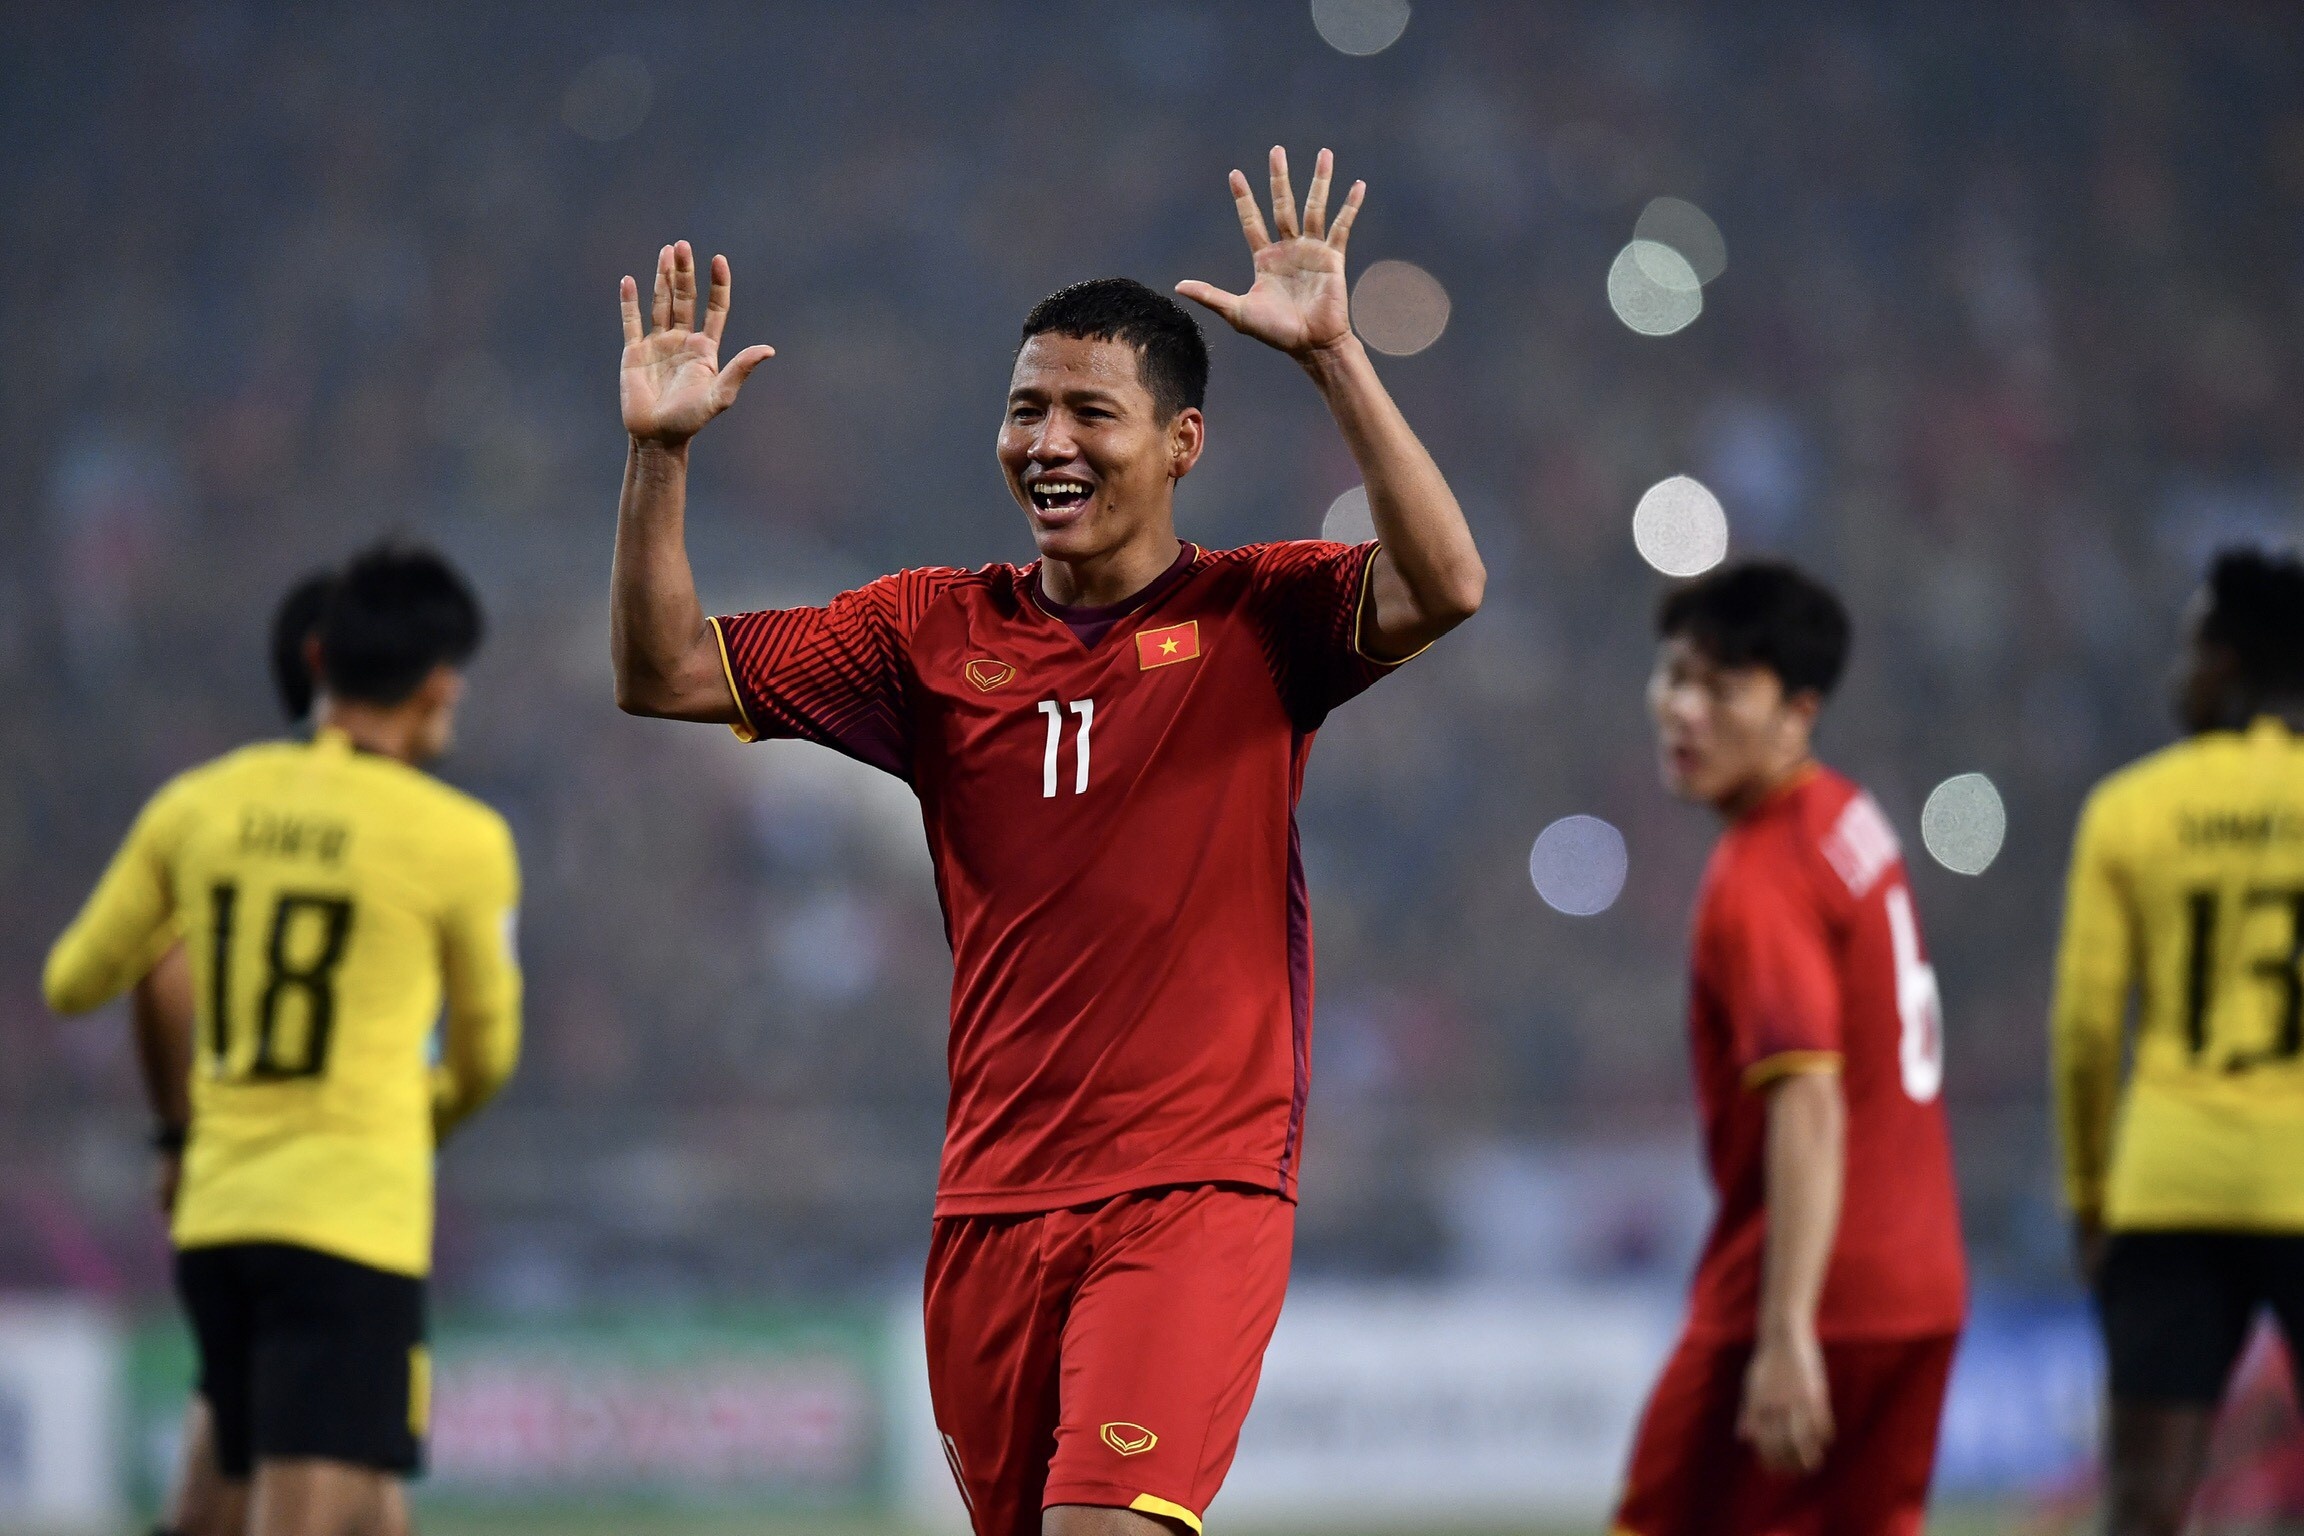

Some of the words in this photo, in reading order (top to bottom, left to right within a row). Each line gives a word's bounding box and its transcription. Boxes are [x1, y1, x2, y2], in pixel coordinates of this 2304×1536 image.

[1038, 698, 1094, 798] 11
[209, 882, 355, 1079] 18
[1885, 884, 1944, 1103] 6
[2184, 884, 2304, 1076] 13
